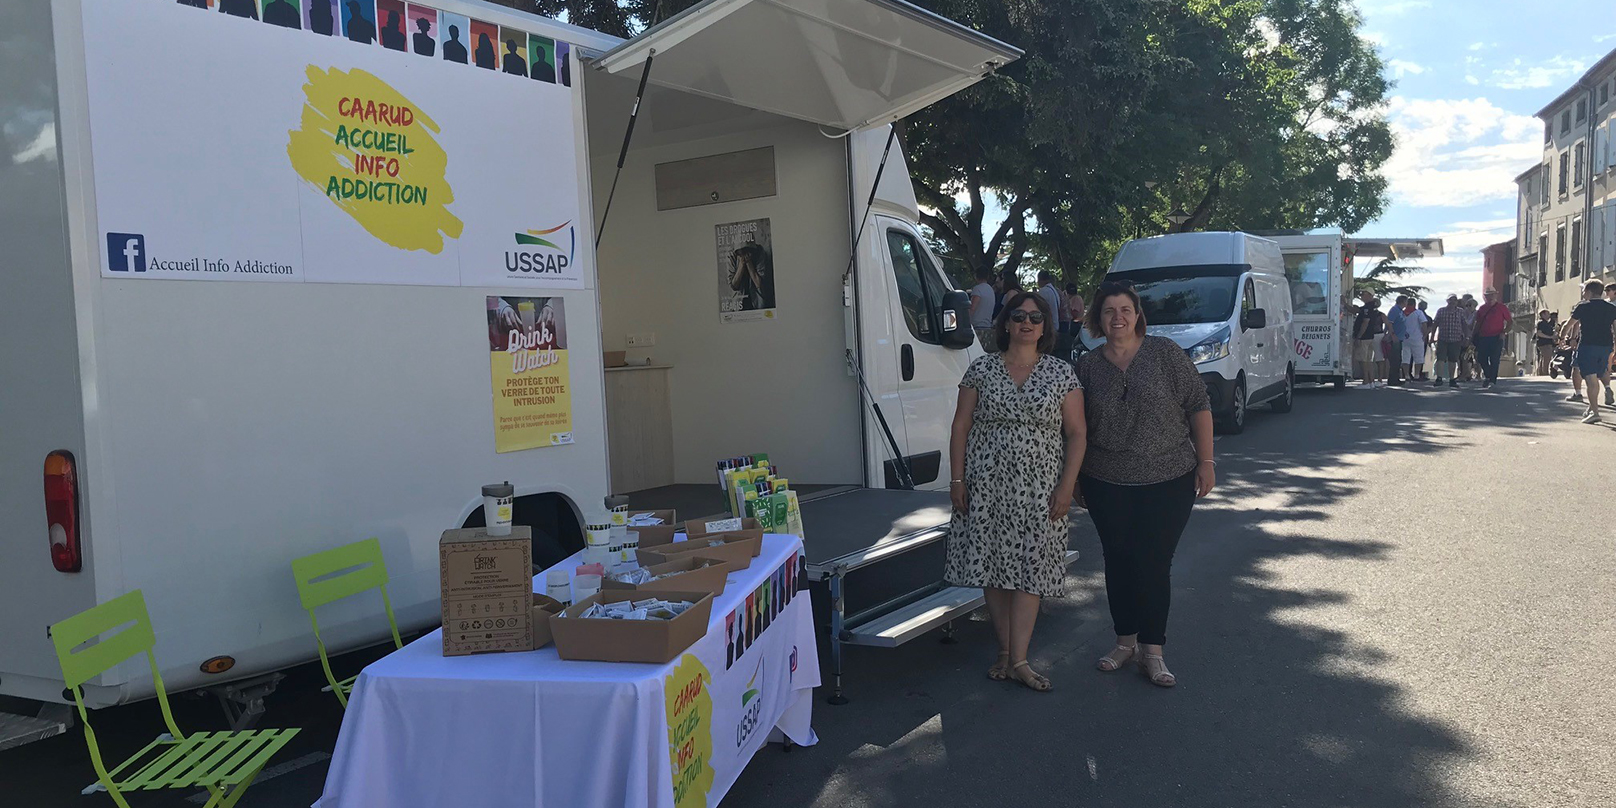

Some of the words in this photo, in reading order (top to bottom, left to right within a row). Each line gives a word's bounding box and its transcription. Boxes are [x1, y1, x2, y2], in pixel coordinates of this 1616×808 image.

[338, 97, 414, 127] CAARUD
[335, 124, 415, 155] ACCUEIL
[355, 153, 400, 178] INFO
[326, 175, 428, 206] ADDICTION
[717, 226, 729, 236] LES
[729, 222, 758, 235] DROGUES
[149, 256, 200, 272] Accueil
[203, 258, 230, 273] Info
[233, 260, 294, 275] Addiction
[505, 251, 569, 274] USSAP
[506, 322, 553, 354] Drink
[512, 345, 559, 374] Watch
[501, 387, 528, 398] VERRE
[529, 387, 540, 396] DE
[540, 385, 565, 395] TOUTE
[506, 375, 543, 387] PROTÈGE
[544, 376, 560, 385] TON
[513, 395, 555, 406] INTRUSION
[673, 672, 703, 718] CAARUD
[736, 697, 761, 748] USSAP
